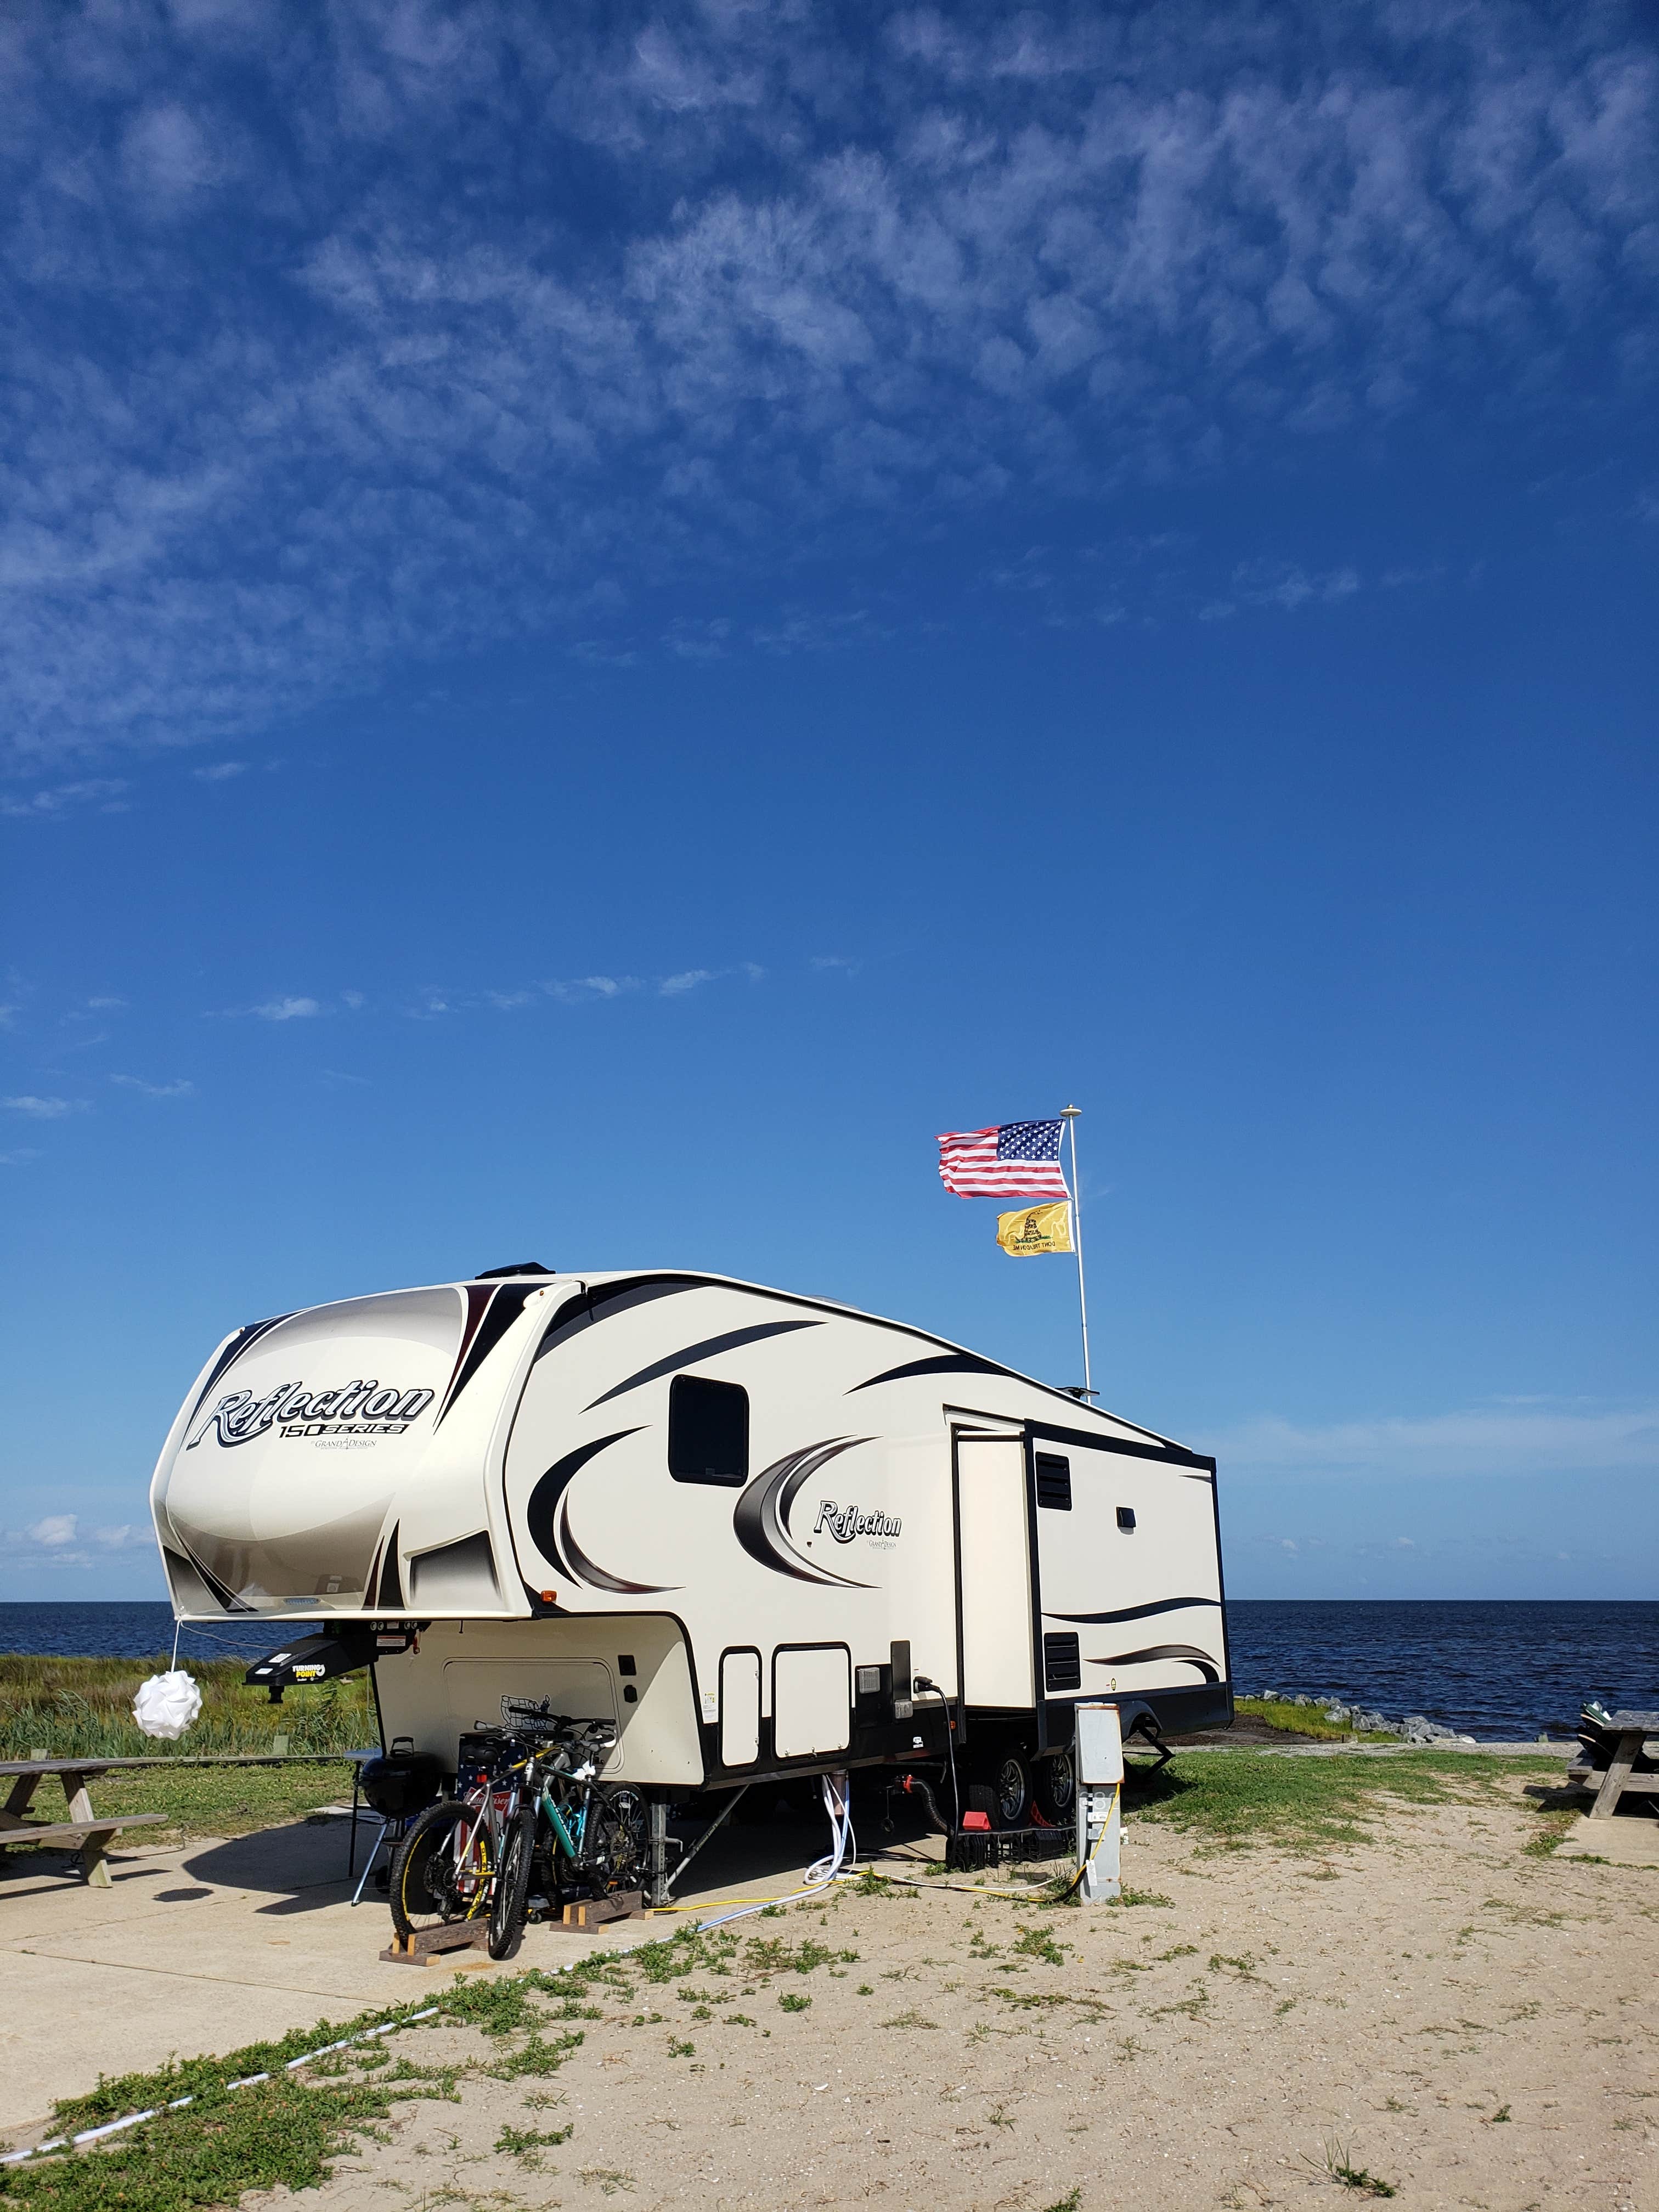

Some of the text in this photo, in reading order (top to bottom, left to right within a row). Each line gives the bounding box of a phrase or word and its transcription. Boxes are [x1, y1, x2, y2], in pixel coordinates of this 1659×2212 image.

[186, 1380, 435, 1450] Reflection
[279, 1424, 406, 1438] 150 SERIES
[814, 1500, 901, 1544] Reflection
[292, 1664, 321, 1672] TURNING
